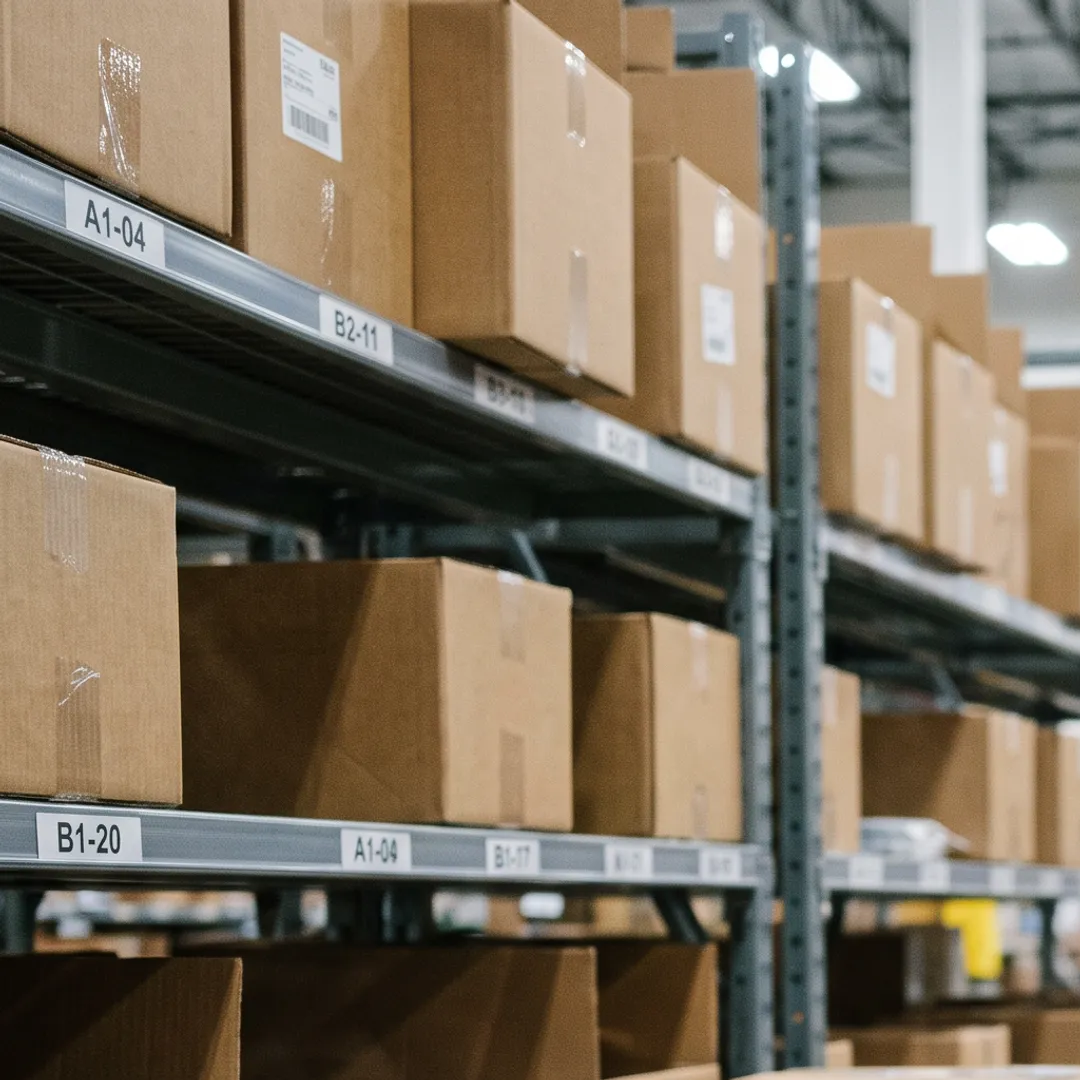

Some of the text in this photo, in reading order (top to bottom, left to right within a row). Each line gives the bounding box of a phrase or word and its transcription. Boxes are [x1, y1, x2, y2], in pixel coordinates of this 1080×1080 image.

[84, 199, 146, 253] A1-04
[335, 309, 379, 351] B2-11
[57, 821, 121, 854] B1-20
